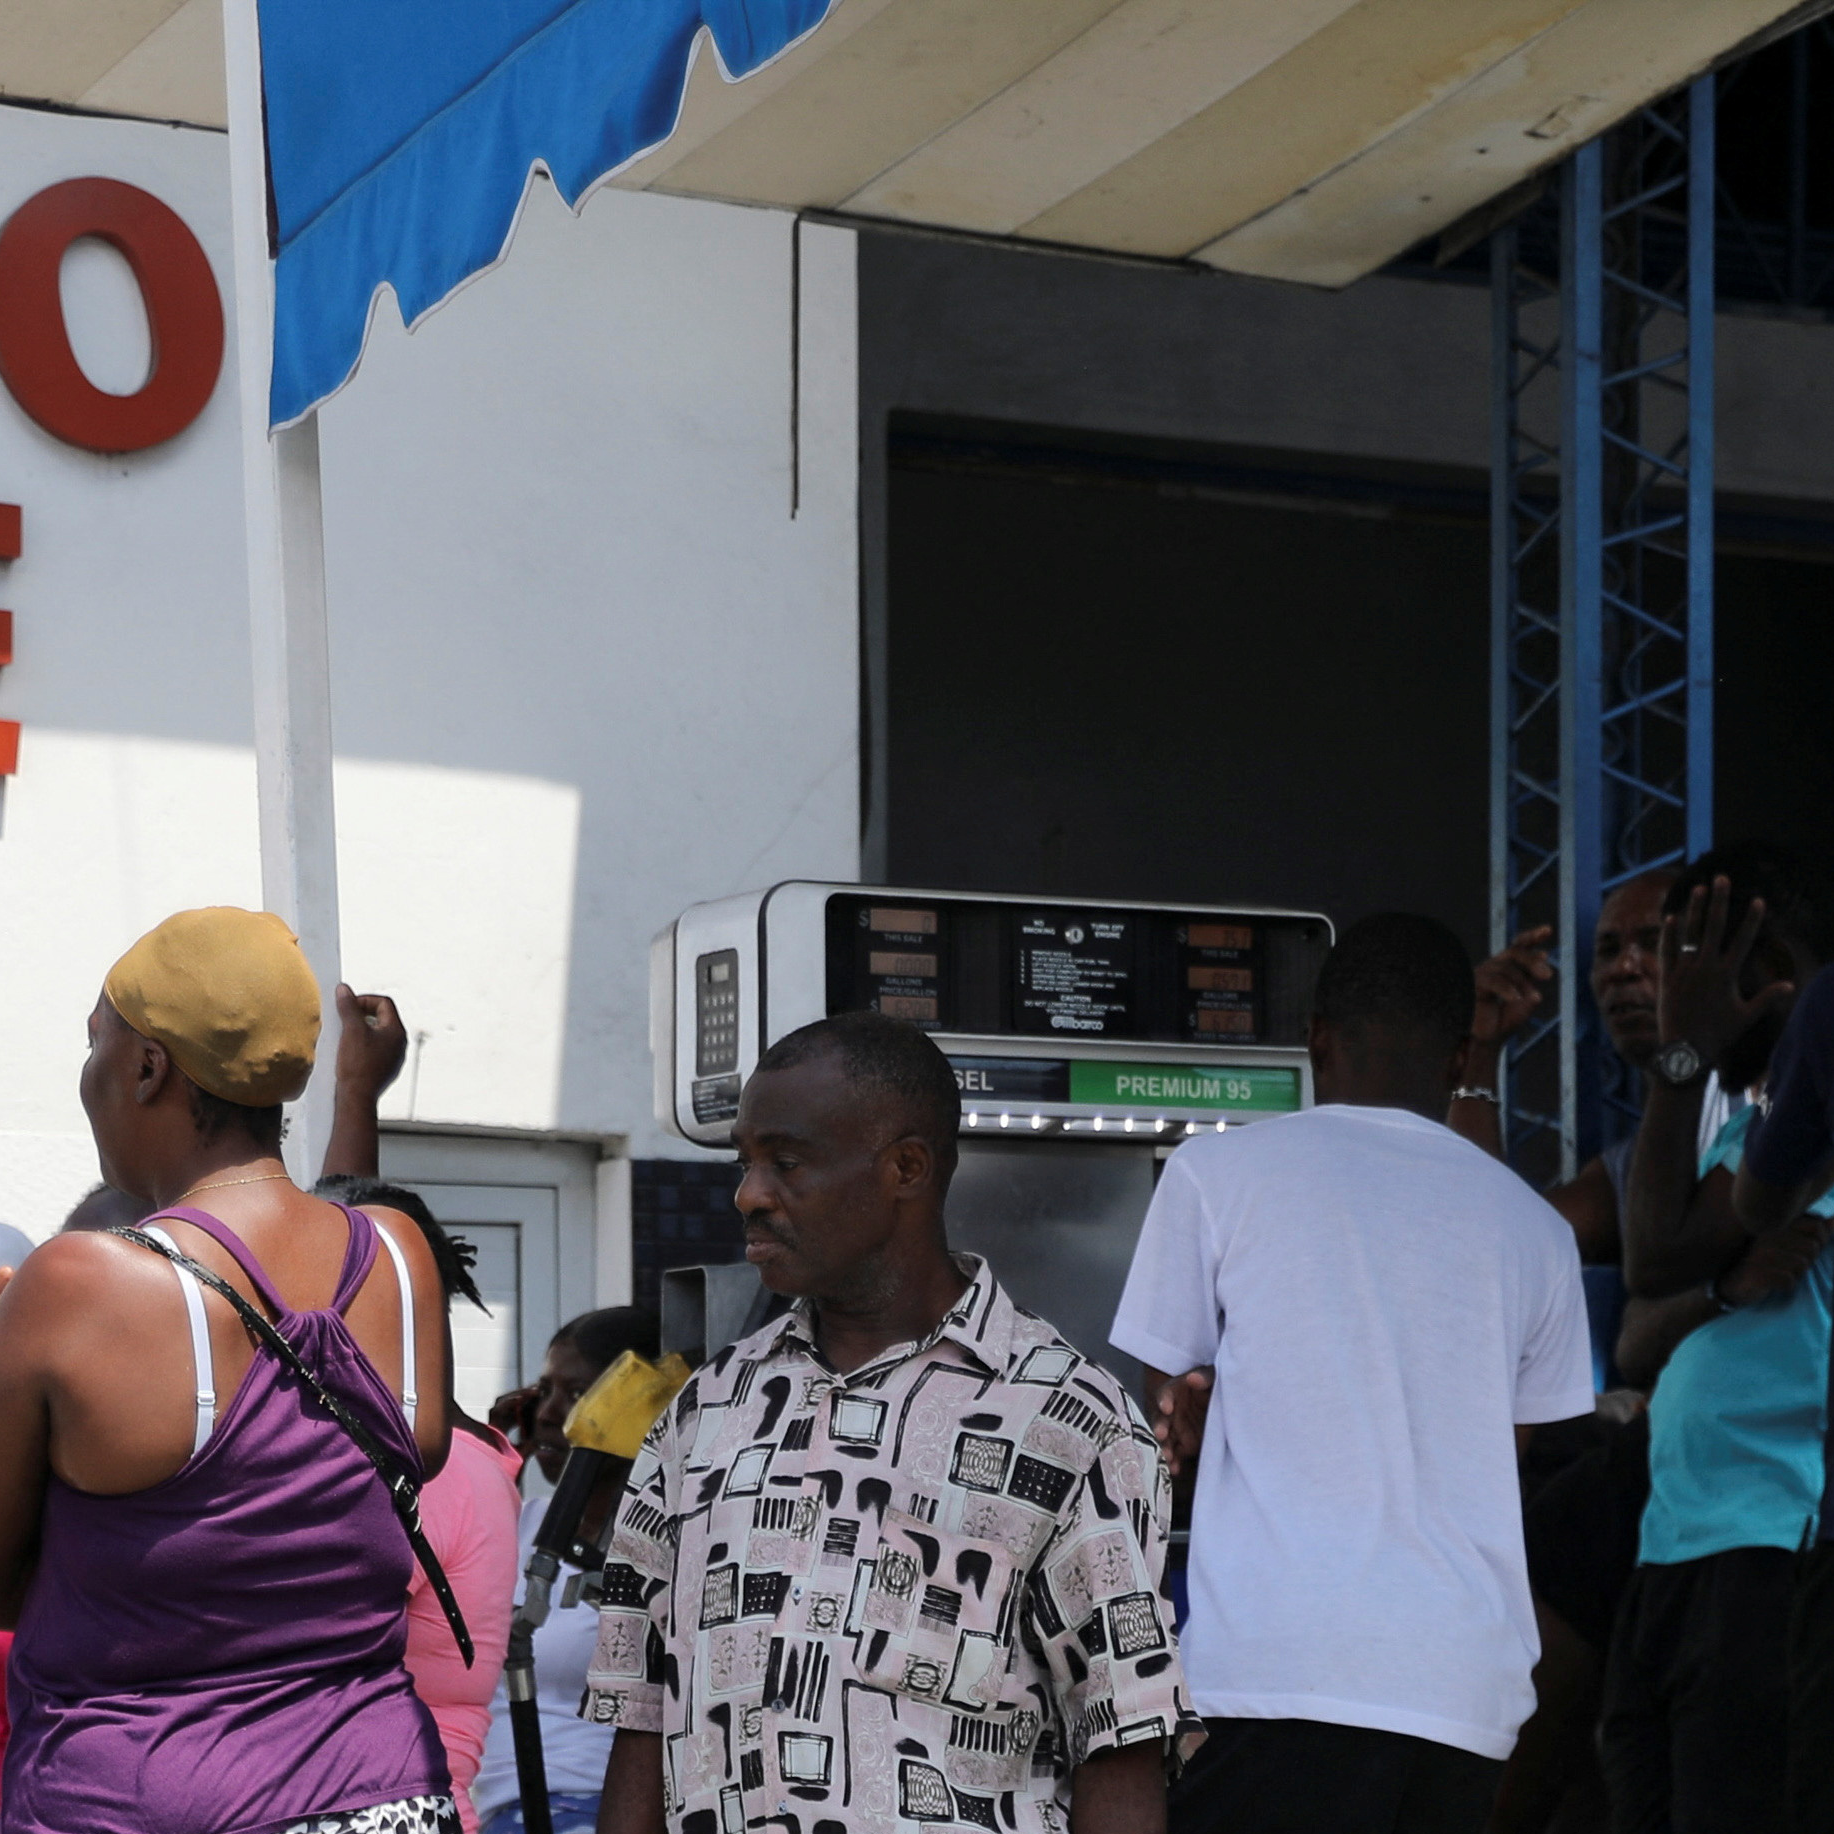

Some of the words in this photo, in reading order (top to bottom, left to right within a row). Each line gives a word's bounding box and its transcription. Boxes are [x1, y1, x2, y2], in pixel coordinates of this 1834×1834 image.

[885, 977, 923, 986] GALLONS
[1050, 1015, 1104, 1031] Gilbarco
[1116, 1075, 1221, 1100] PREMIUM
[1225, 1079, 1252, 1101] 95
